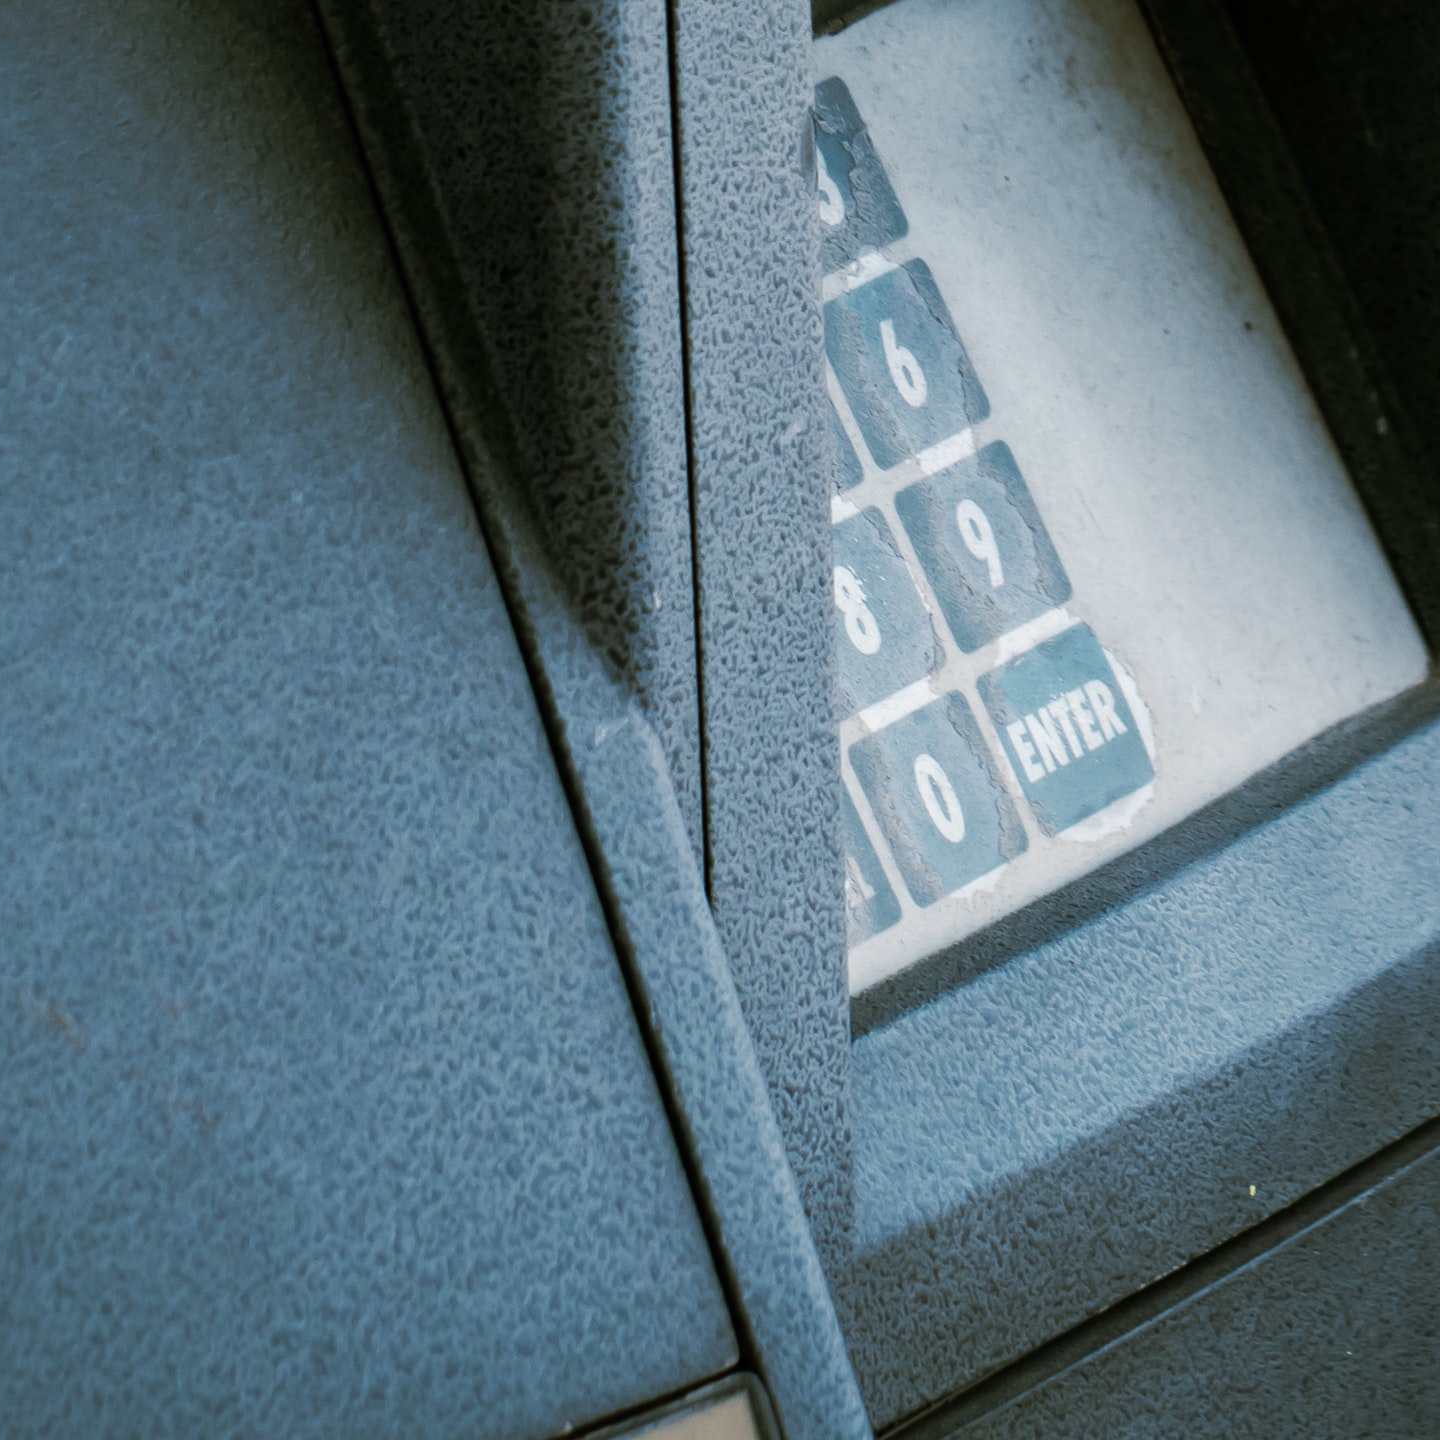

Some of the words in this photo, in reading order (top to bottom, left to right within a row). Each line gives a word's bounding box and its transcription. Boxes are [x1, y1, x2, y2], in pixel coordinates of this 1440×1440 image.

[880, 320, 927, 407] 6
[956, 499, 1005, 588] 9
[833, 566, 882, 656] 8
[1006, 679, 1128, 784] ENTER
[913, 754, 964, 843] 0
